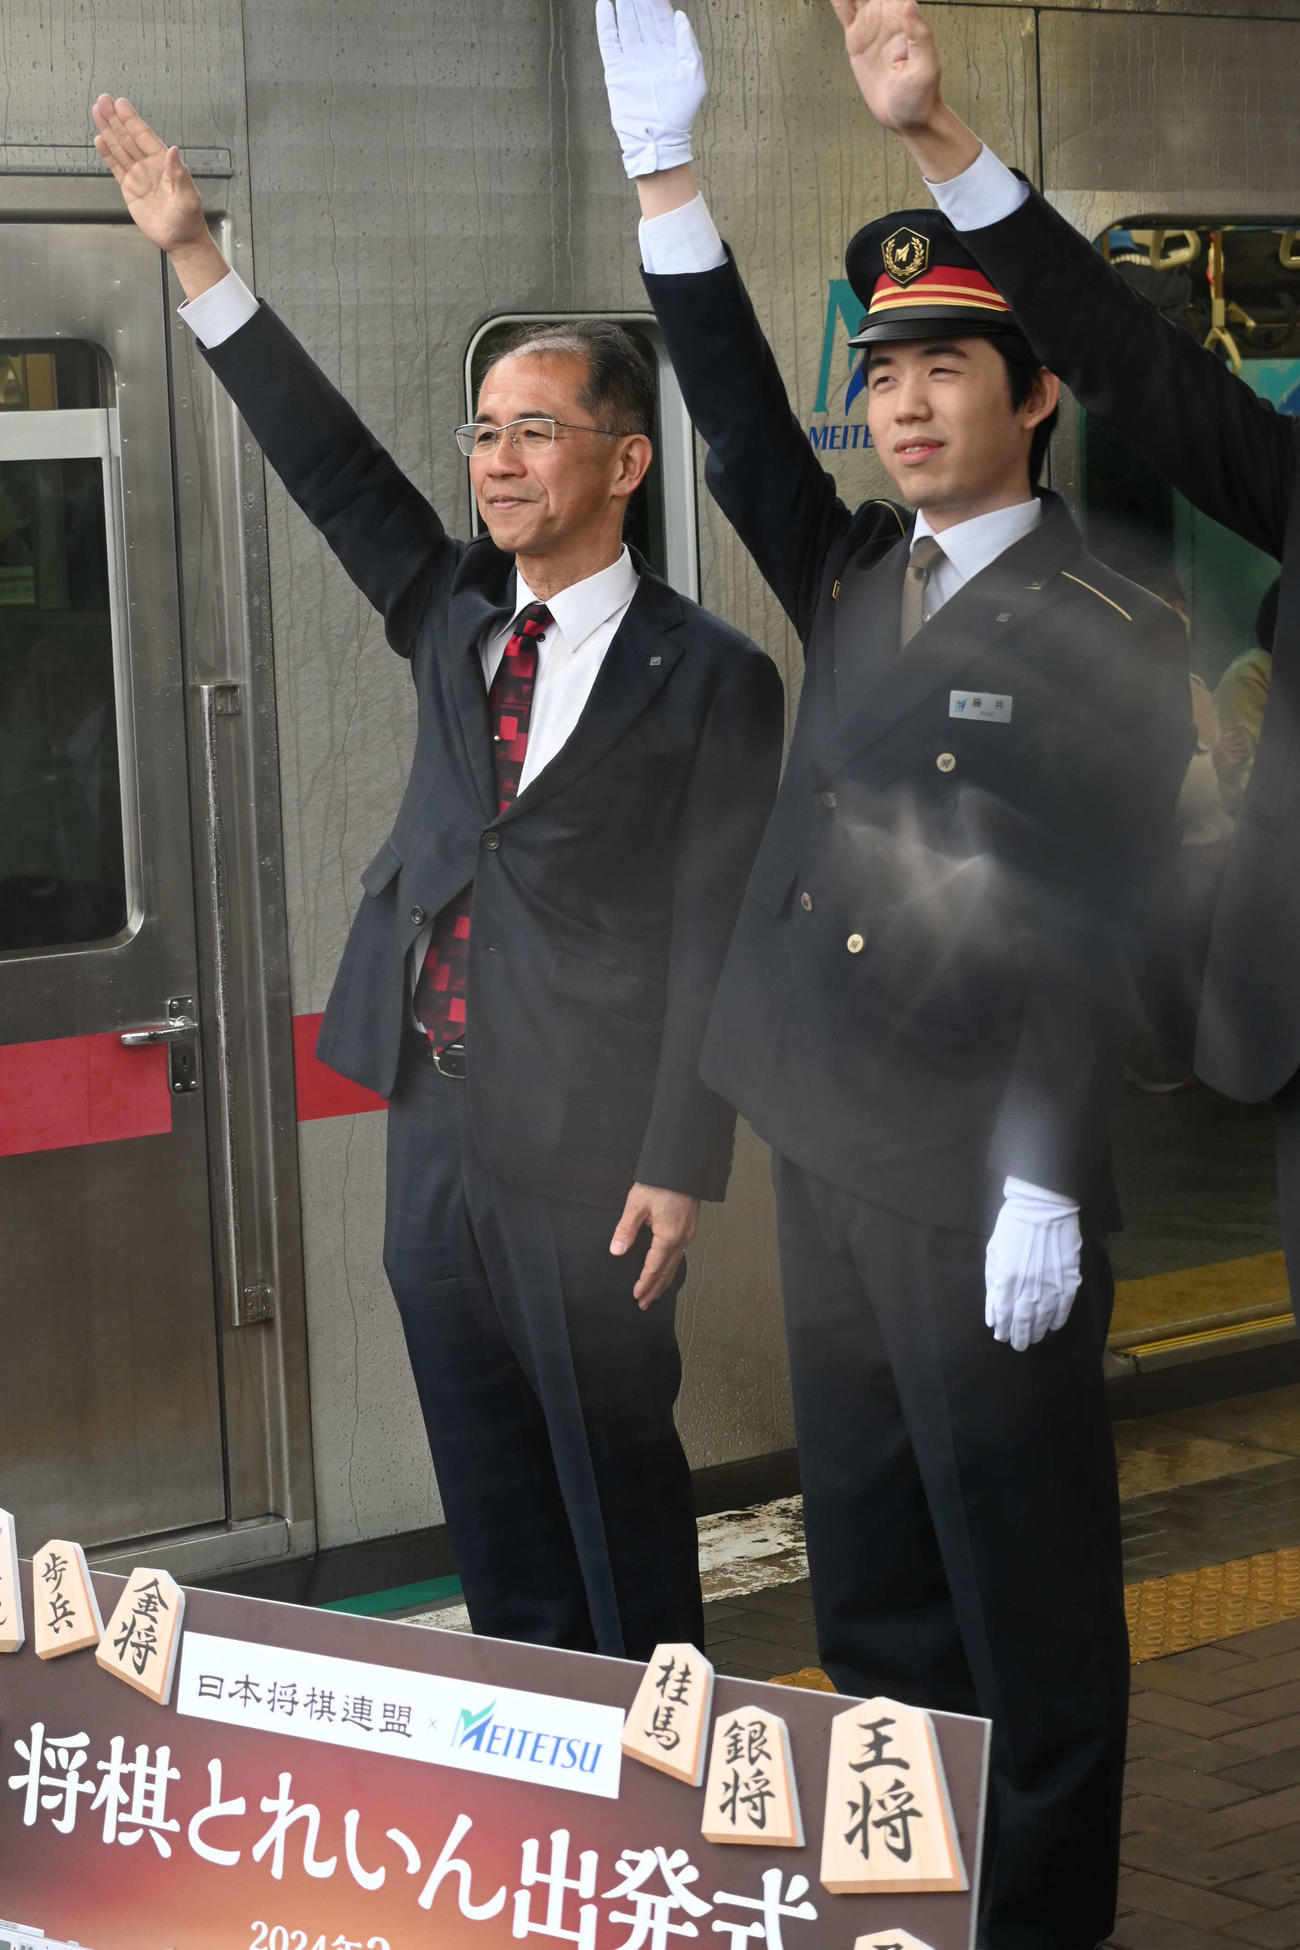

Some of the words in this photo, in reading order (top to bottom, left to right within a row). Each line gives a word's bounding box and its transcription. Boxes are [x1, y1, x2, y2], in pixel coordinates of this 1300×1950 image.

[42, 1553, 76, 1634] 歩兵
[113, 1578, 169, 1676] 金将
[198, 1674, 413, 1738] 日本将棋連盟
[450, 1698, 603, 1774] MEITETSU
[644, 1656, 692, 1751] 桂馬
[718, 1719, 776, 1830] 銀将
[844, 1716, 924, 1864] 王将
[8, 1721, 818, 1950] 将棋とれいん出発式
